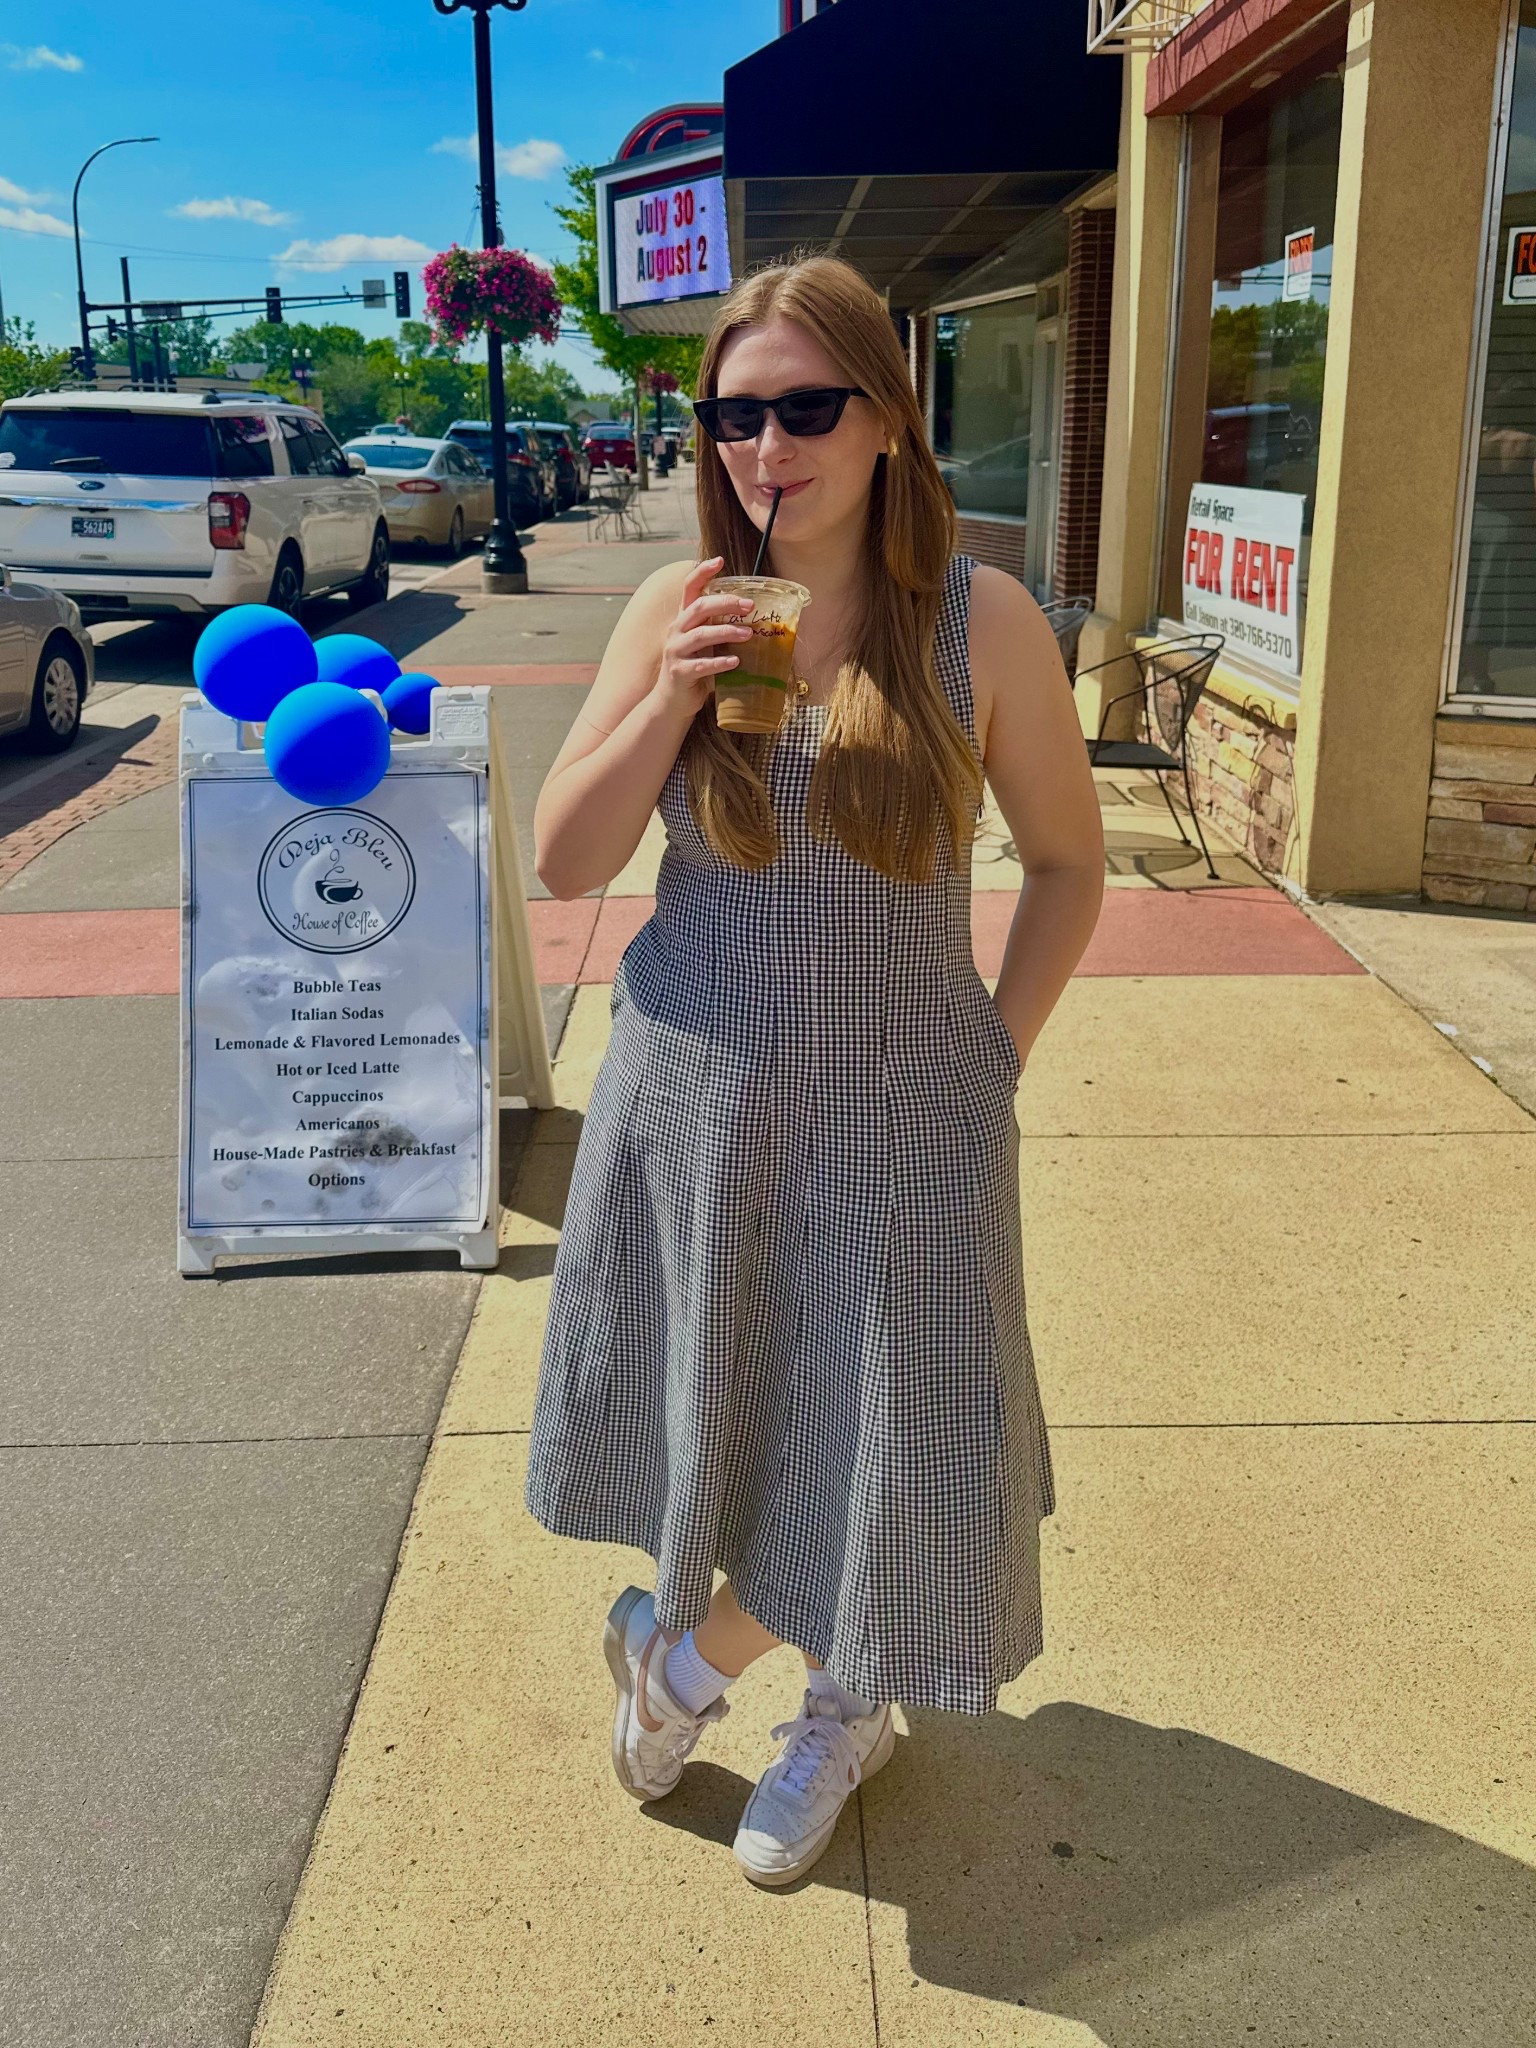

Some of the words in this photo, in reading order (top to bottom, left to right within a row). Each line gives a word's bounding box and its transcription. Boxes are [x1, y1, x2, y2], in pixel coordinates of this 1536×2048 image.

[636, 197, 667, 235] July
[674, 188, 694, 228] 30
[637, 237, 691, 283] August
[697, 234, 707, 272] 2
[1190, 497, 1210, 519] Retail
[1212, 499, 1234, 525] Space
[1185, 528, 1223, 595] FOR
[1231, 537, 1295, 616] RENT
[1185, 601, 1197, 621] Call
[1220, 616, 1229, 634] at
[279, 833, 335, 869] Deja
[342, 827, 393, 871] Bleu
[292, 911, 330, 931] House
[331, 911, 344, 936] of
[344, 910, 379, 936] Coffee
[293, 980, 344, 994] Bubble
[348, 979, 382, 992] Teas
[291, 1008, 337, 1021] Italian
[341, 1006, 384, 1020] Sodas
[215, 1036, 289, 1051] Lemonade
[292, 1035, 306, 1049] &
[311, 1033, 376, 1049] Flavored
[380, 1032, 460, 1047] Lemonades
[276, 1063, 303, 1077] Hot
[306, 1066, 322, 1076] or
[326, 1062, 358, 1076] Iced
[362, 1061, 400, 1075] Latte
[292, 1089, 384, 1107] Cappuccinos
[295, 1117, 380, 1132] Americanos
[212, 1145, 305, 1162] House-Made
[308, 1145, 366, 1160] Pastries
[369, 1143, 384, 1158] &
[387, 1142, 457, 1157] Breakfast
[307, 1171, 366, 1190] Options
